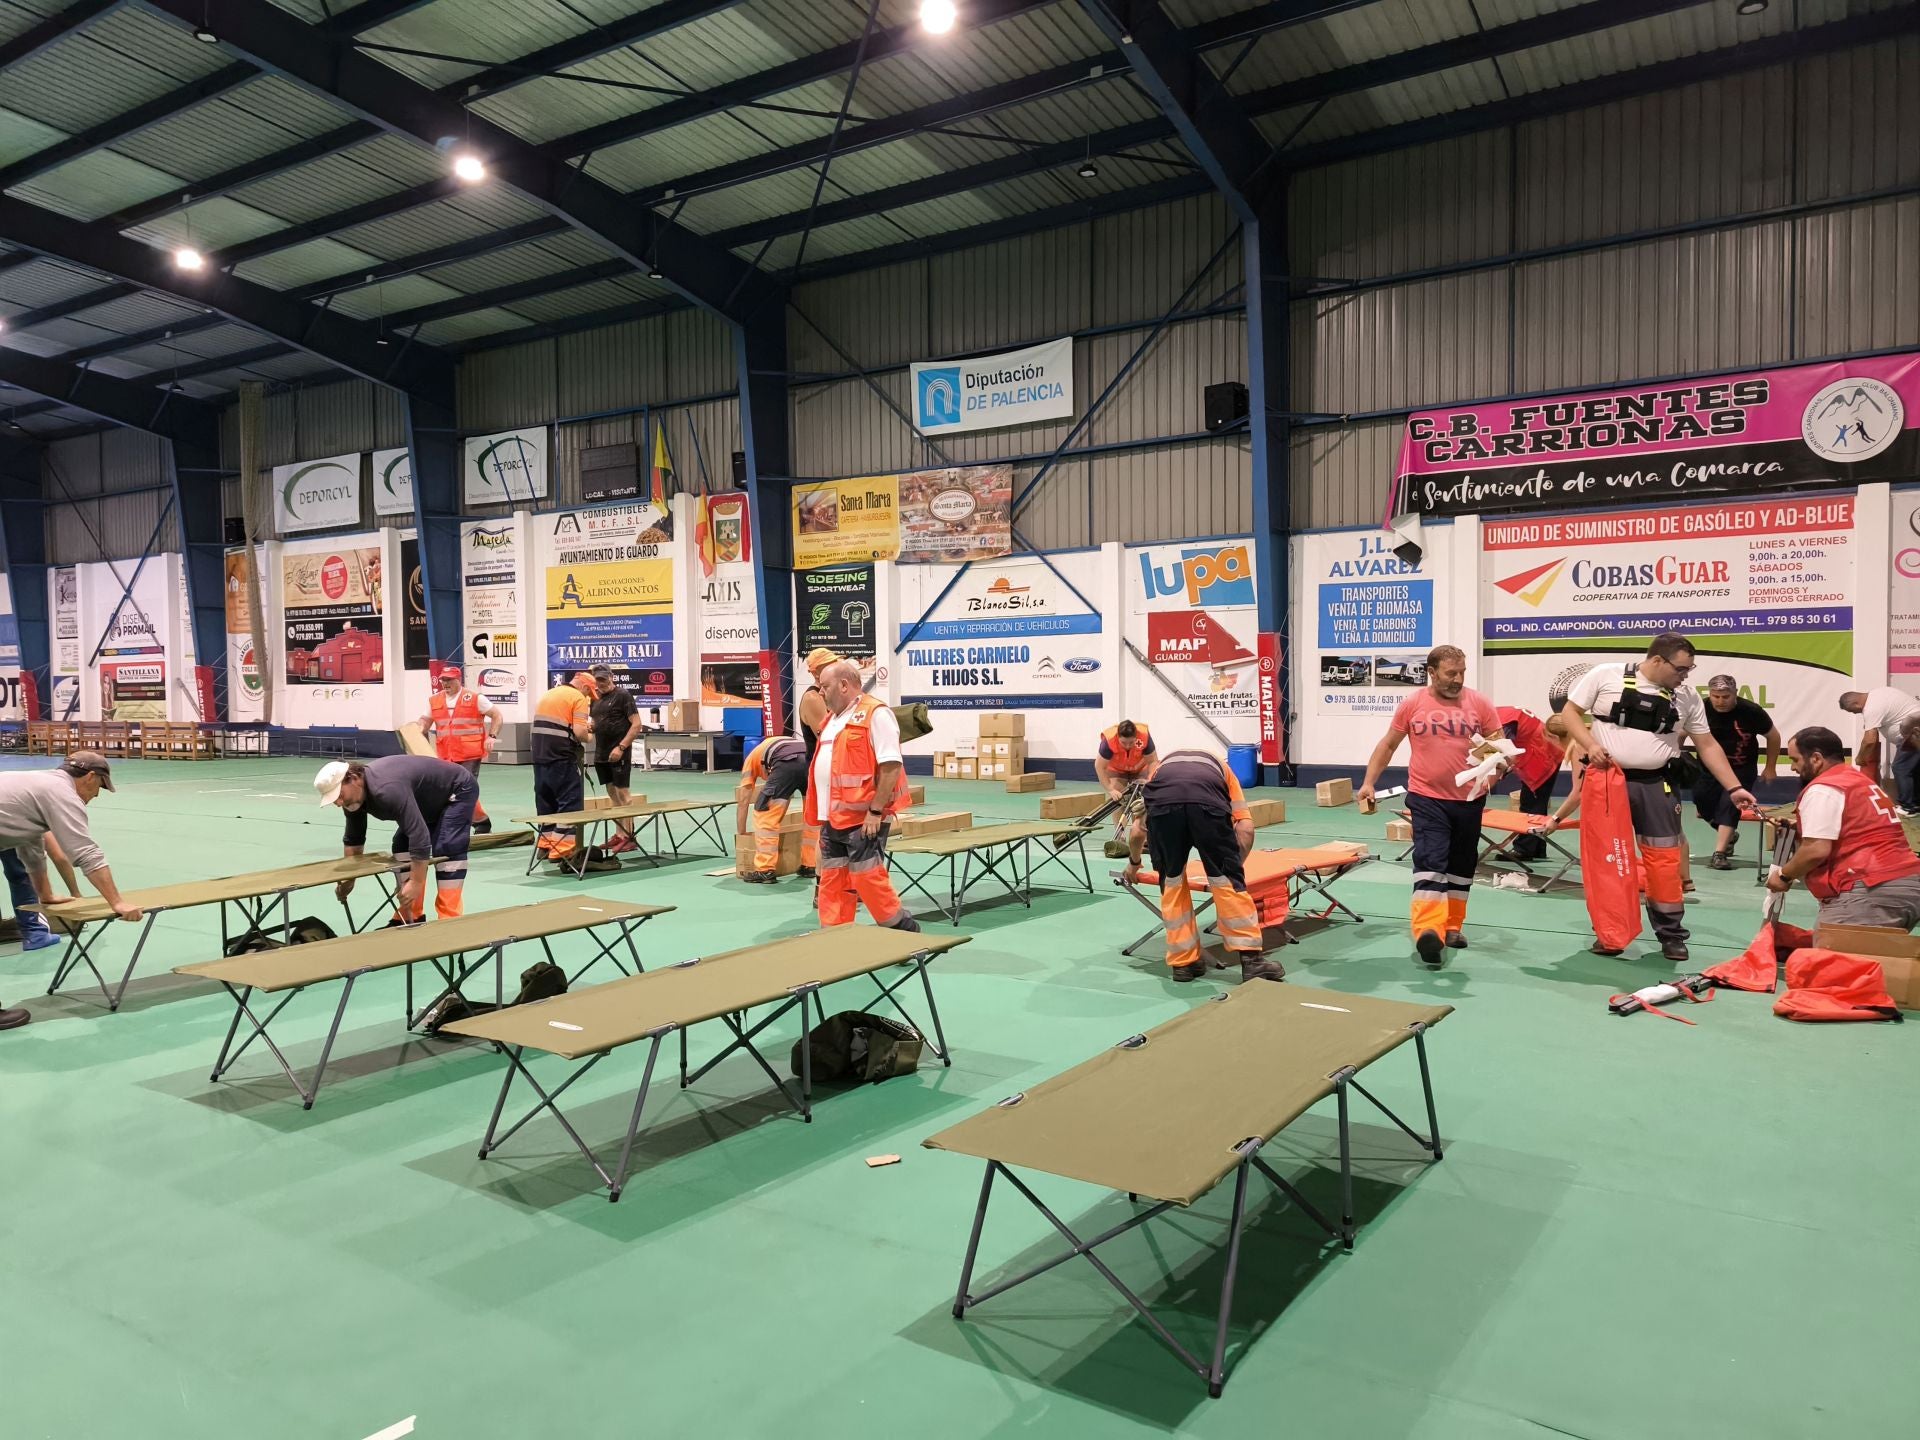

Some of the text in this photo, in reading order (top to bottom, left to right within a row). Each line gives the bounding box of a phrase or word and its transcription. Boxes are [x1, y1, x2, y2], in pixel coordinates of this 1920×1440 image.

[966, 364, 1044, 390] Diputación
[1862, 381, 1879, 391] CLUB
[967, 382, 1064, 411] DE PALENCIA
[1409, 379, 1770, 442] C.B. FUENTES
[1425, 409, 1746, 463] CARRIONAS
[1425, 469, 1554, 510] Sentimiento
[1562, 471, 1597, 493] de
[1606, 470, 1661, 488] una
[1670, 461, 1785, 488] Comarca
[299, 485, 352, 505] DEPORCYL
[585, 490, 605, 499] LOCAL
[841, 491, 891, 512] Santa Marta
[582, 504, 648, 520] COMBUSTIBLES
[1488, 503, 1849, 545] UNIDAD DE SUMINISTRO DE GASÓLEO Y AD-BLUE
[1360, 536, 1392, 558] J.L.
[1749, 536, 1848, 550] LUNES A VIERNES
[559, 548, 613, 564] AYUNTAMIENTO
[615, 547, 624, 559] DE
[627, 544, 658, 558] GUARDO
[1749, 552, 1779, 562] 9,00h.
[1790, 549, 1827, 560] 20,00h.
[1329, 557, 1423, 578] ALVAREZ
[1749, 561, 1803, 573] SÁBADOS
[598, 577, 645, 586] EXCAVACIONES
[805, 571, 868, 584] GDESING
[1139, 545, 1251, 606] lupa
[1749, 575, 1779, 585] 9,00h.
[1790, 573, 1827, 584] 15,00h.
[586, 584, 659, 597] ALBINO SANTOS
[807, 584, 866, 593] SPORTWEAR
[1341, 585, 1409, 602] TRANSPORTES
[1572, 588, 1730, 602] COOPERATIVA DE TRANSPORTES
[1749, 586, 1809, 596] DOMINGOS Y
[1749, 593, 1844, 604] FESTIVOS CERRADO
[1328, 600, 1423, 617] VENTA DE BIOMASA
[934, 619, 1070, 635] VENTA Y REPARACIÓN DE VEHÍCULOS
[1333, 617, 1417, 631] VENTA DE CARBONES
[1496, 614, 1836, 632] POL. IND. CAMPONDÓN. GUARDO (PALENCIA). TEL. 979 85 30 61
[1334, 629, 1416, 644] Y LEÑA A DOMICILIO
[558, 644, 661, 659] TALLERES RAUL
[907, 645, 1030, 666] TALLERES CARMELO
[1155, 653, 1193, 662] GUARDO
[118, 667, 160, 676] SANTILLANA
[1069, 659, 1095, 671] Ford
[932, 668, 1004, 686] E HIJOS S.L.
[761, 684, 774, 736] MAPFRE
[1261, 675, 1275, 741] MAPFRE
[1613, 838, 1624, 877] FERRINO
